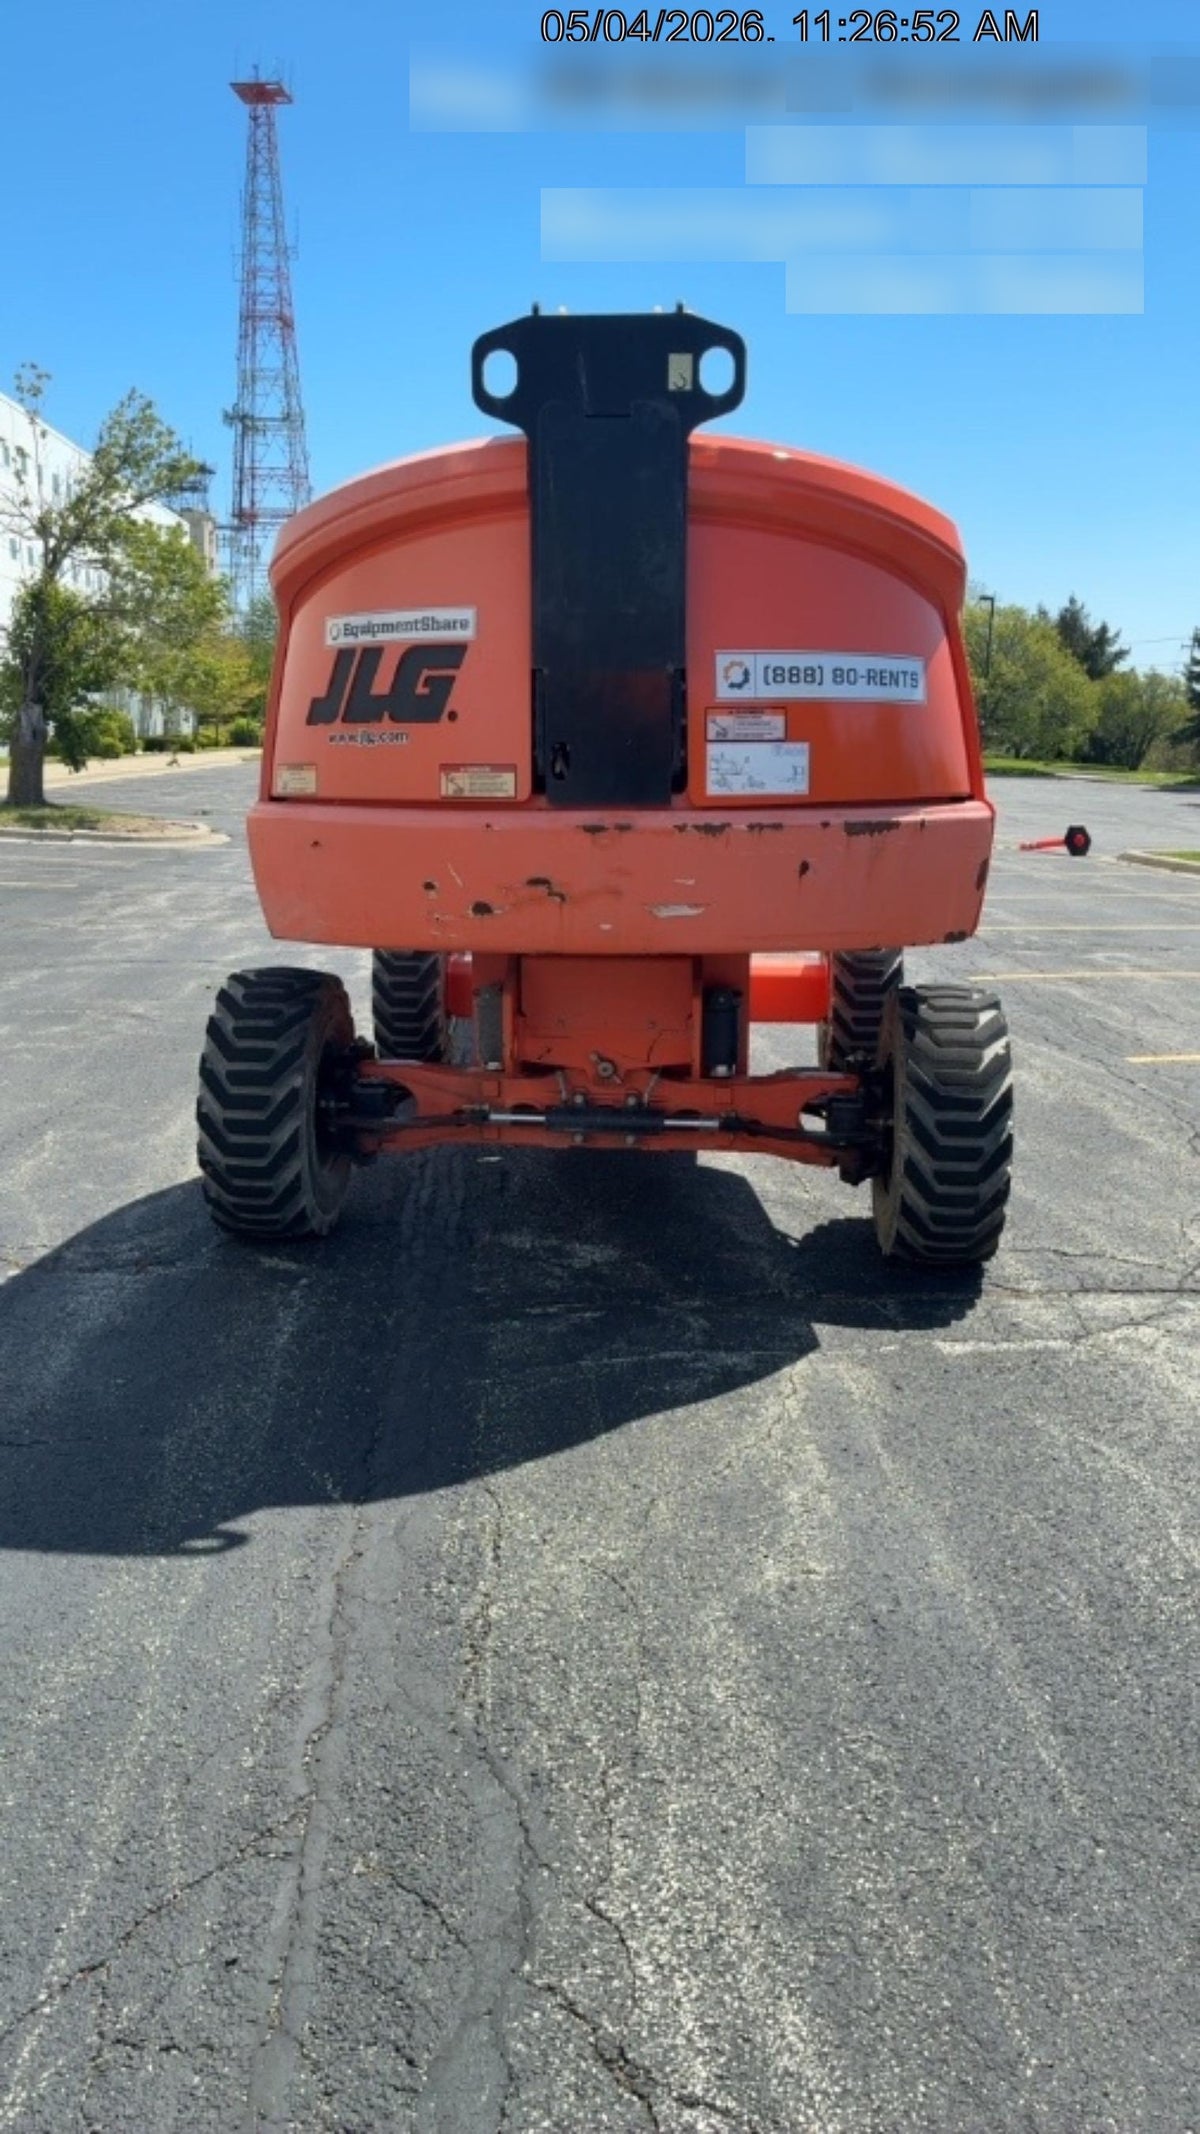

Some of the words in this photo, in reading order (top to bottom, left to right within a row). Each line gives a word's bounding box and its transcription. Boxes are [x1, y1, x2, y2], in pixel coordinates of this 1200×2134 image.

[343, 617, 469, 637] EquipmentShare
[763, 664, 823, 686] (888)
[832, 667, 918, 688] 80-RENTS
